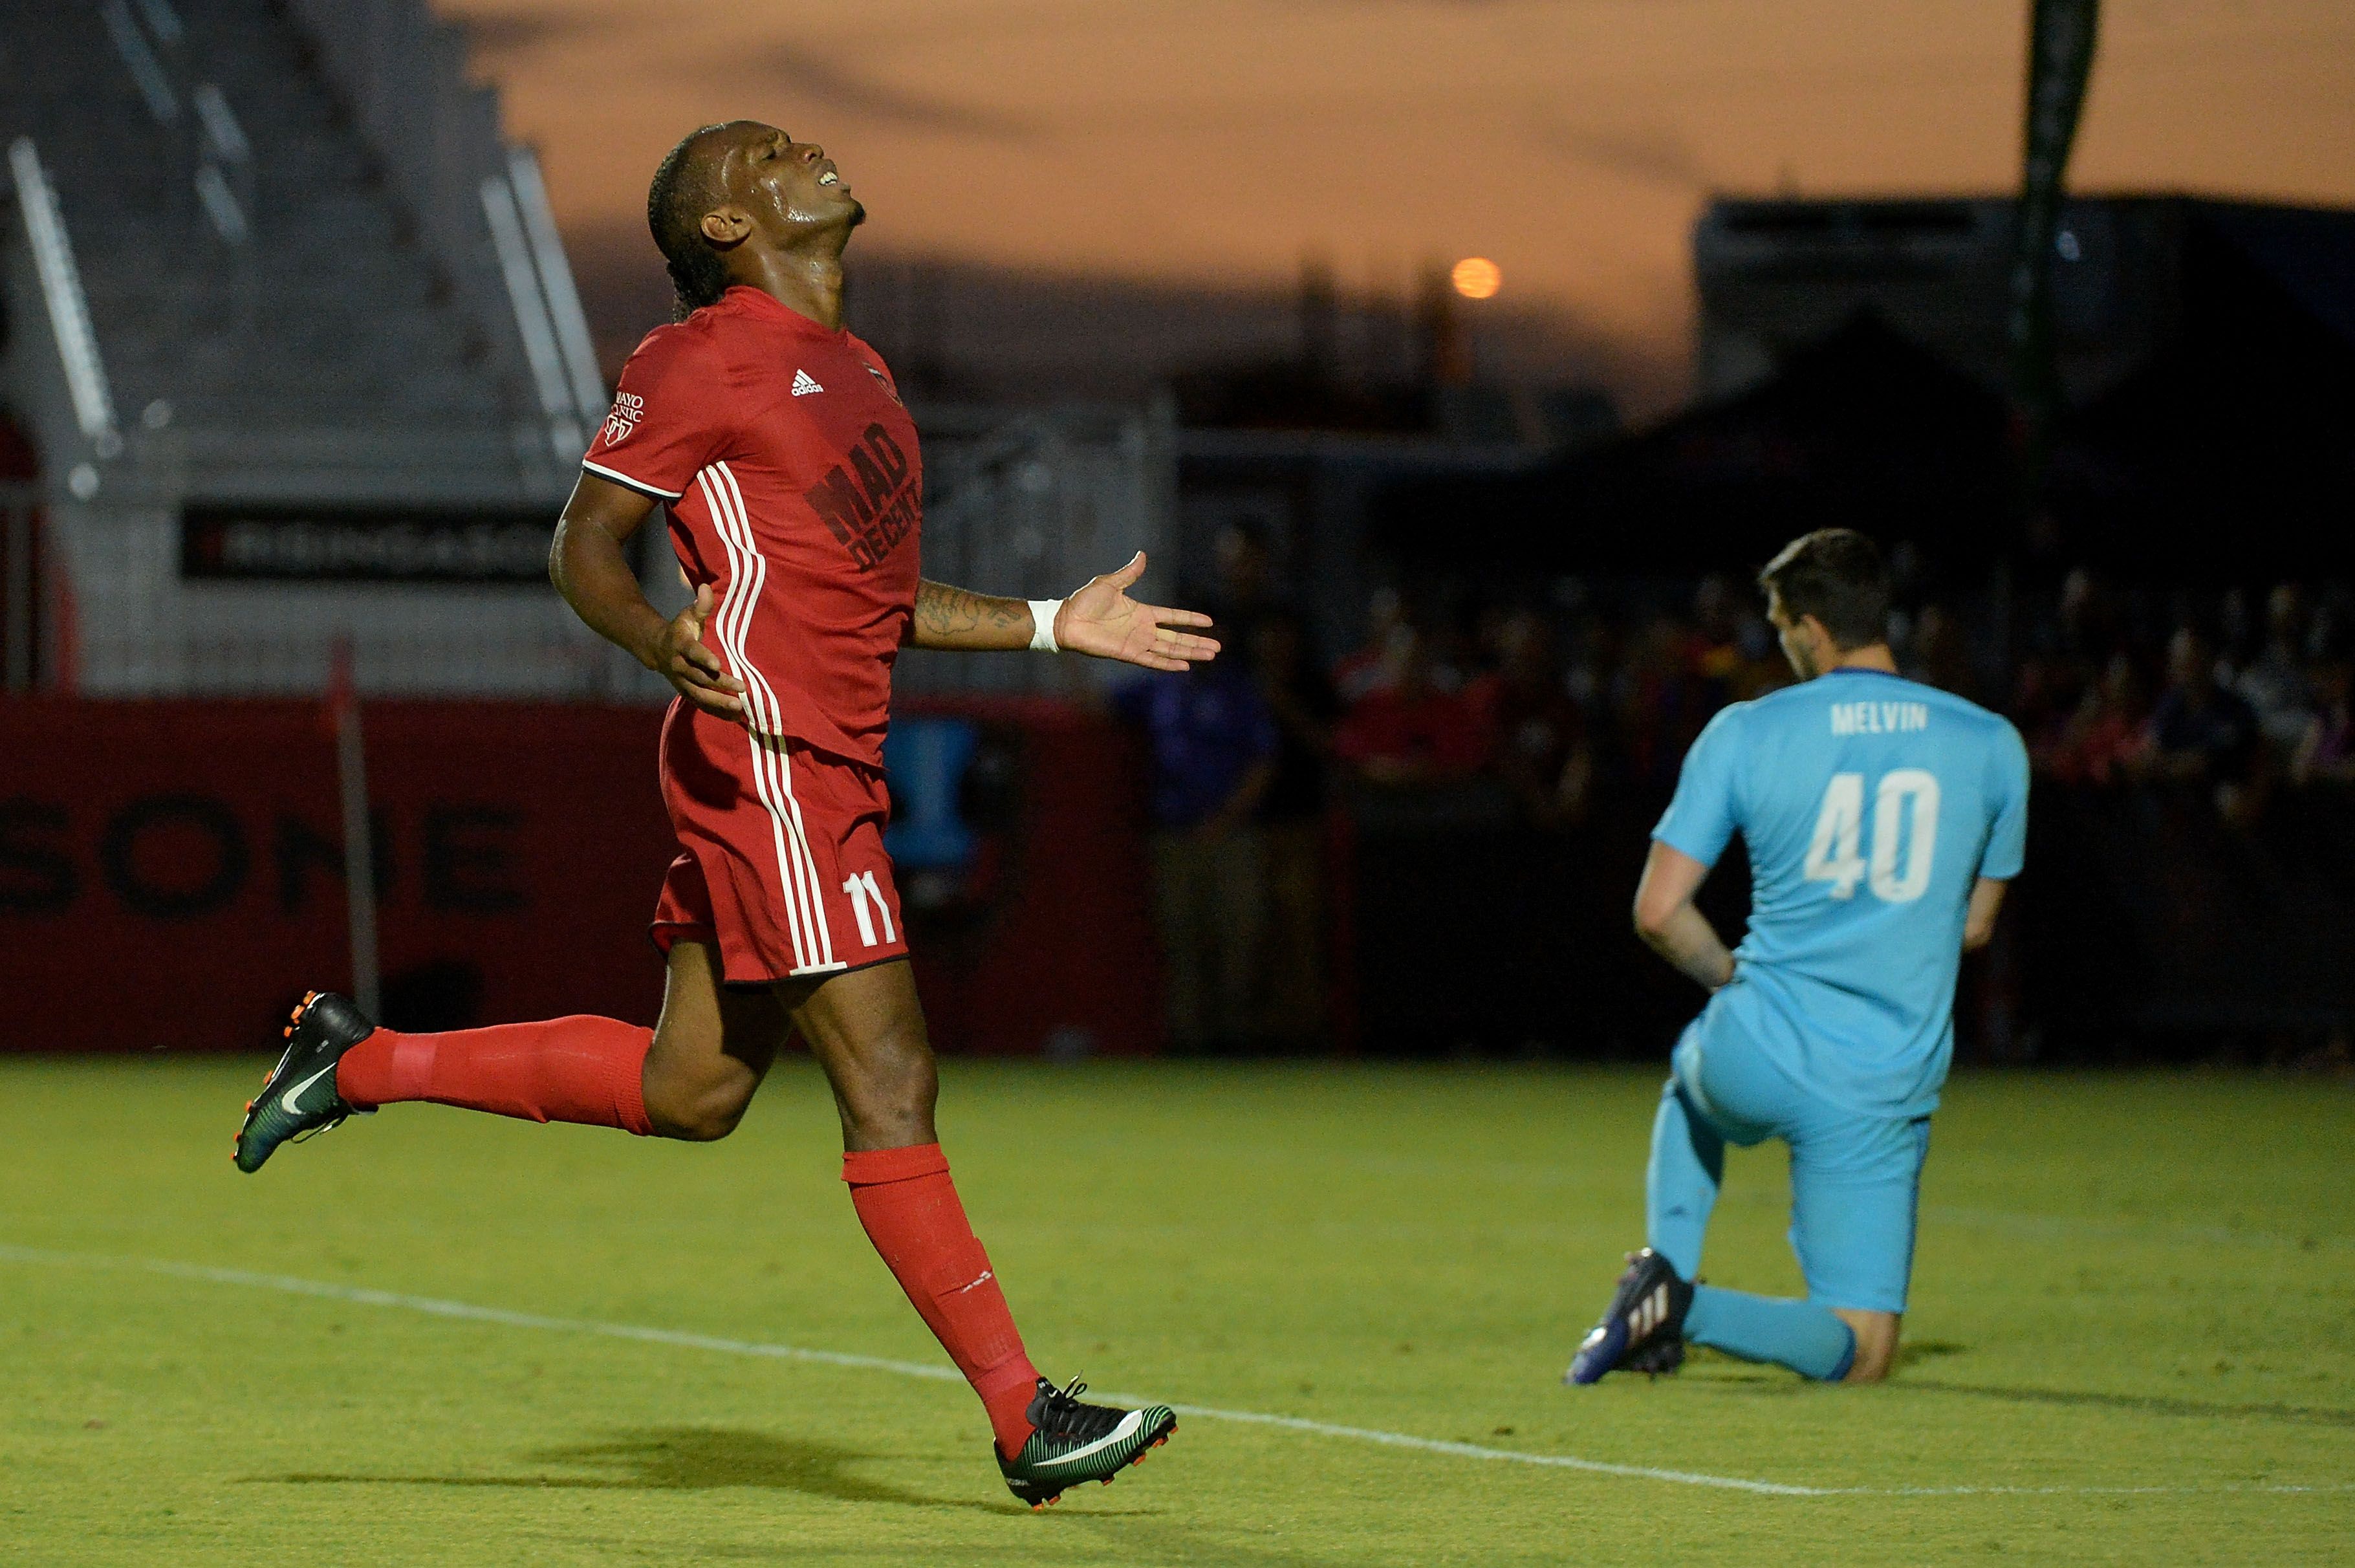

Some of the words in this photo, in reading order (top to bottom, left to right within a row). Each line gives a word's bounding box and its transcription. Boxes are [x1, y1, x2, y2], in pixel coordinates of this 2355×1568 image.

[791, 384, 823, 397] adidas
[803, 422, 908, 546] MAD
[848, 477, 922, 574] DECENT
[1831, 701, 1929, 735] MELVIN
[1804, 768, 1940, 903] 40
[843, 871, 896, 947] 11
